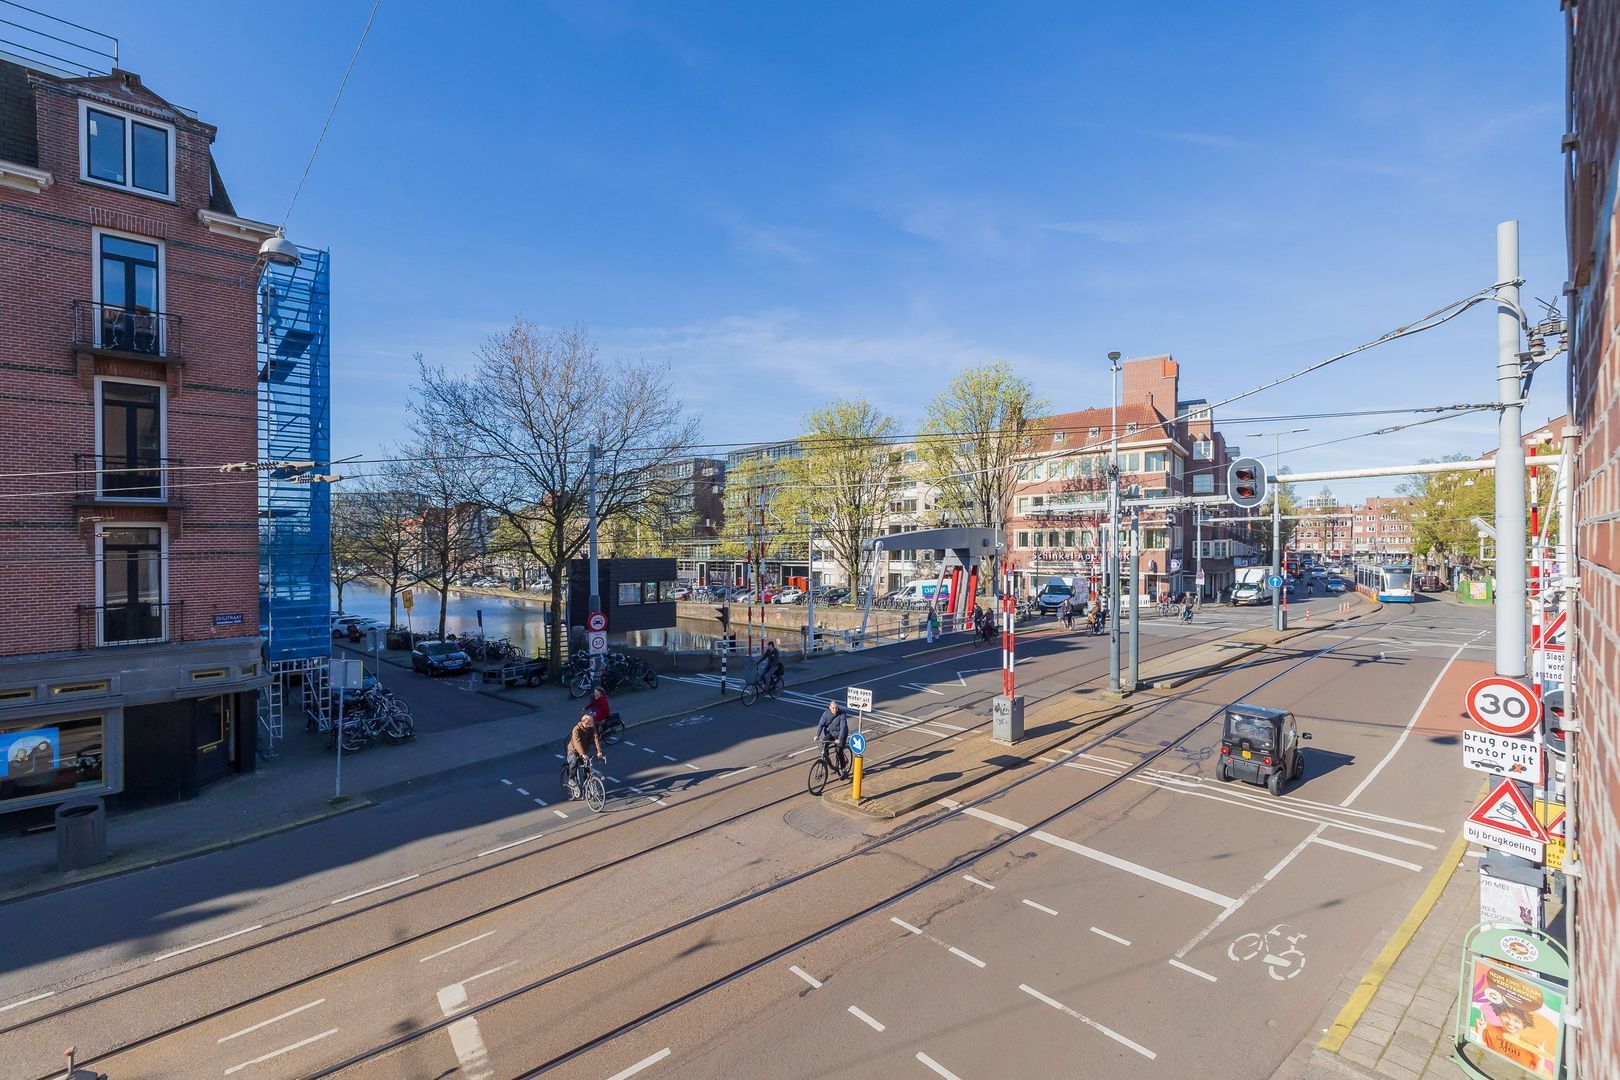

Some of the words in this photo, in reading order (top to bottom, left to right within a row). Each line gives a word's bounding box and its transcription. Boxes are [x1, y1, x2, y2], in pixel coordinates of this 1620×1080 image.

[1032, 551, 1075, 561] Schinkel
[1480, 693, 1526, 718] 30
[1464, 732, 1496, 747] brug
[1502, 741, 1538, 753] open
[1464, 745, 1506, 759] motor
[1512, 755, 1534, 765] uit
[1468, 828, 1480, 838] bij
[1482, 832, 1537, 855] brugkoeling
